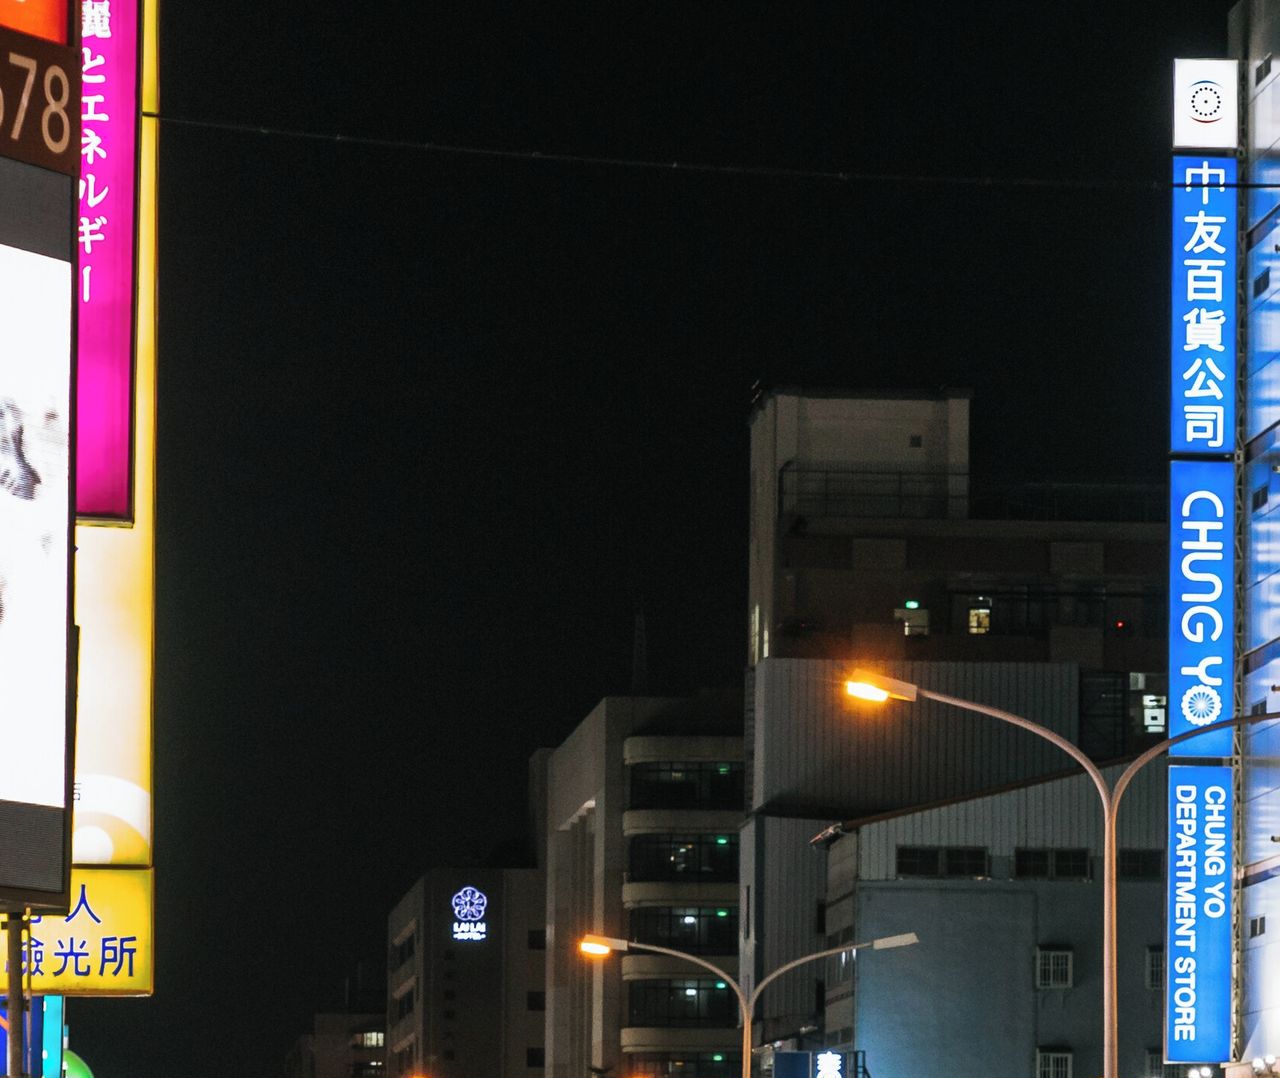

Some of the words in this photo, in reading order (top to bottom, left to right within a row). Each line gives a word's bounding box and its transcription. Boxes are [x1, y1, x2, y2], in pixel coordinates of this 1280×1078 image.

[1182, 161, 1227, 448] 中友百貨公司
[1181, 490, 1224, 643] CHUNG
[1175, 785, 1197, 952] DEPARTMENT
[1204, 785, 1226, 876] CHUNG
[1204, 881, 1226, 918] YO
[1174, 956, 1196, 1041] STORE
